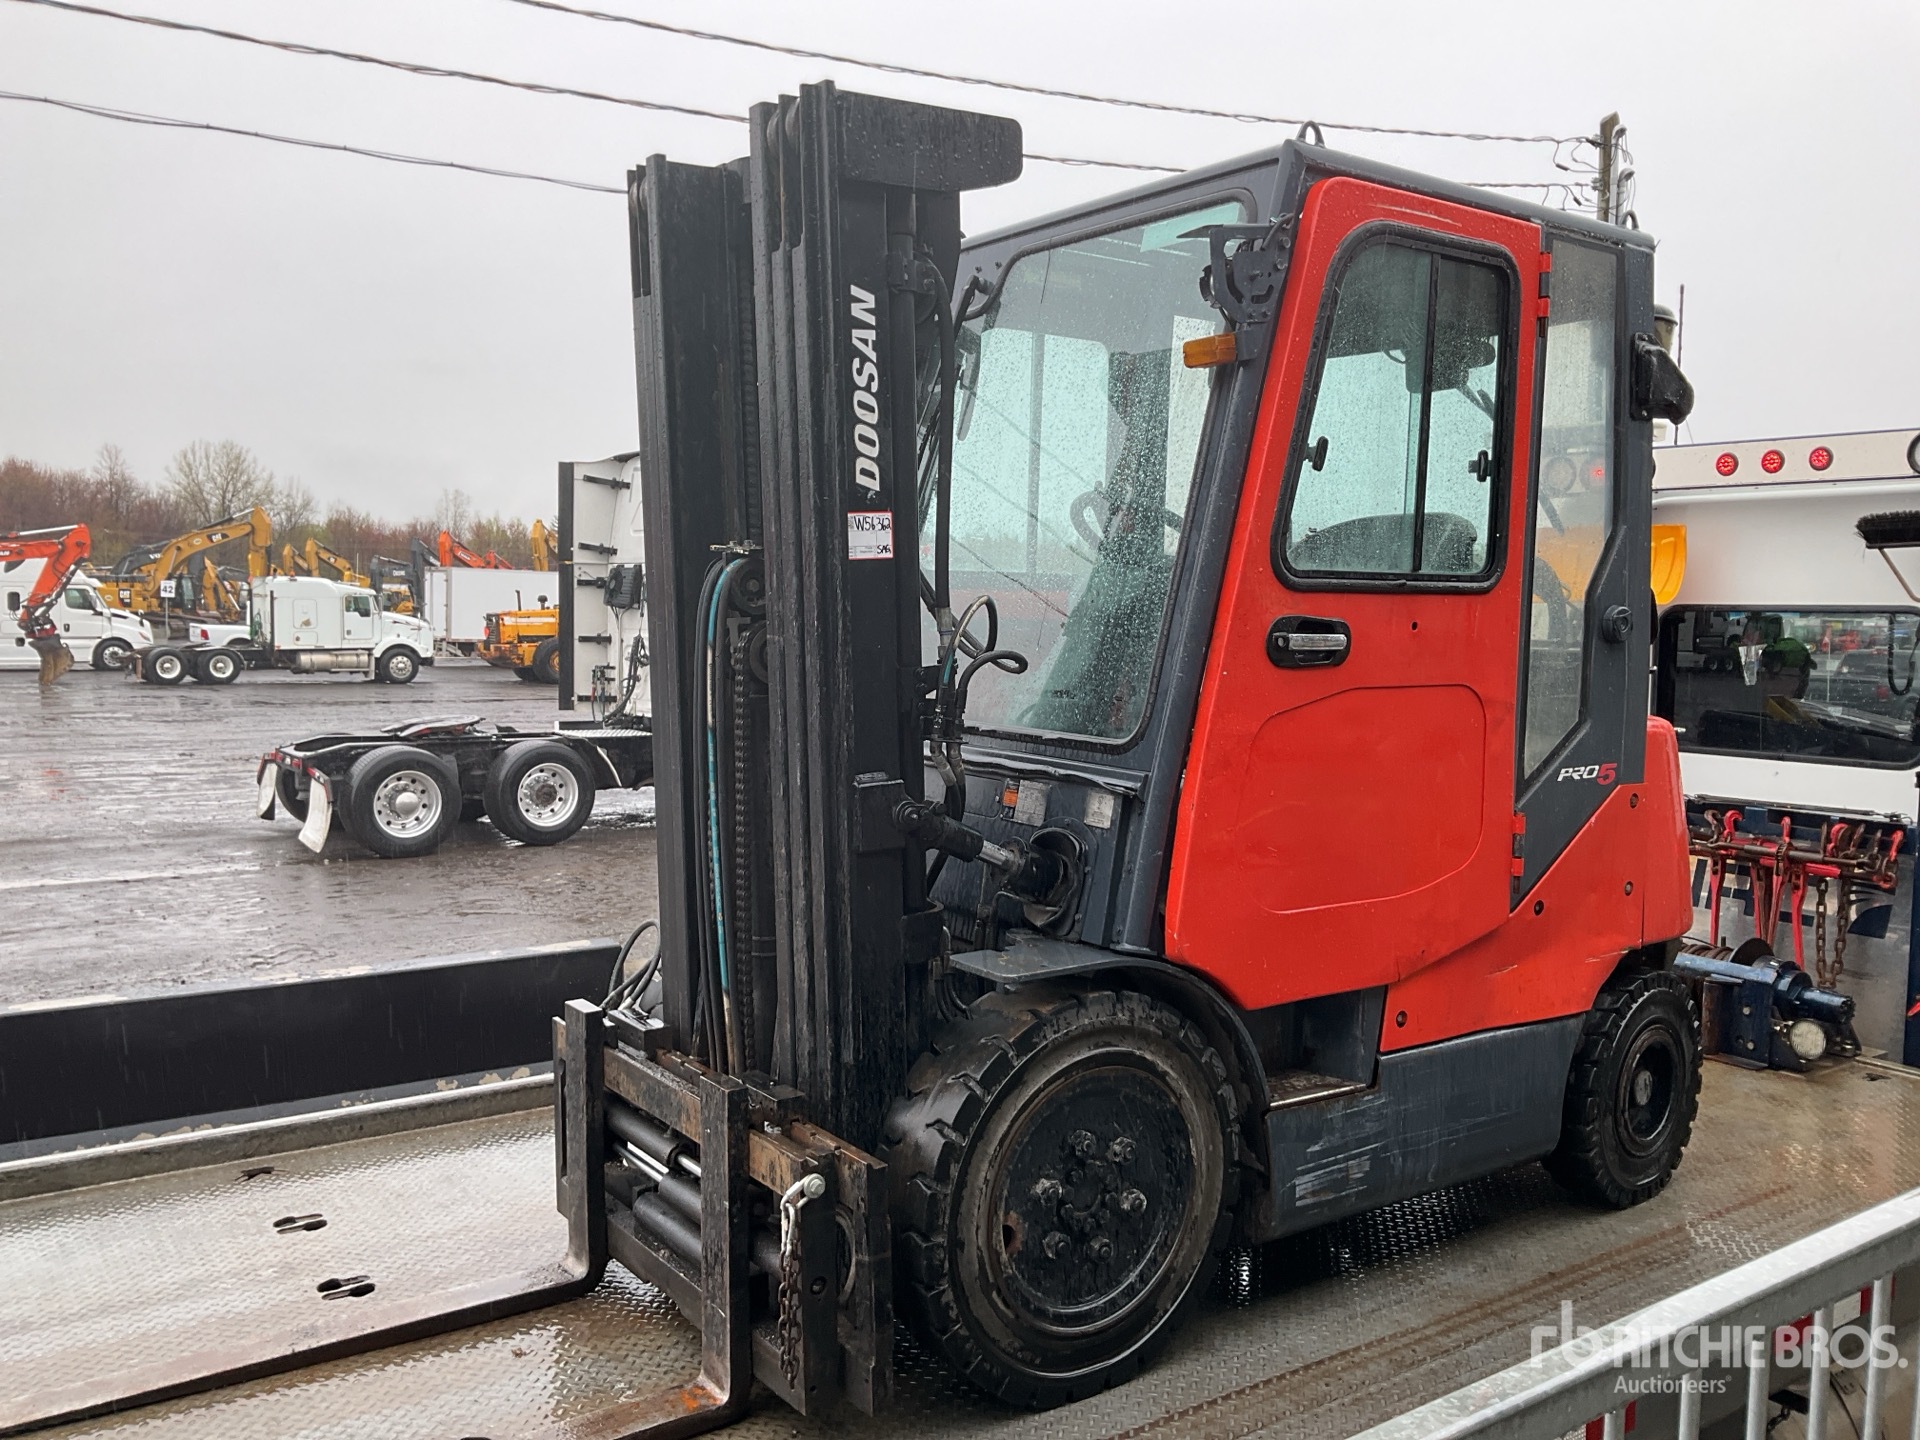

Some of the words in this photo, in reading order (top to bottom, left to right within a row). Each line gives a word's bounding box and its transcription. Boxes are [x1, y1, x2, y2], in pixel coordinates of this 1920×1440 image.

[850, 284, 880, 491] DOOSAN
[162, 585, 174, 594] 42
[1556, 763, 1618, 786] PRO5
